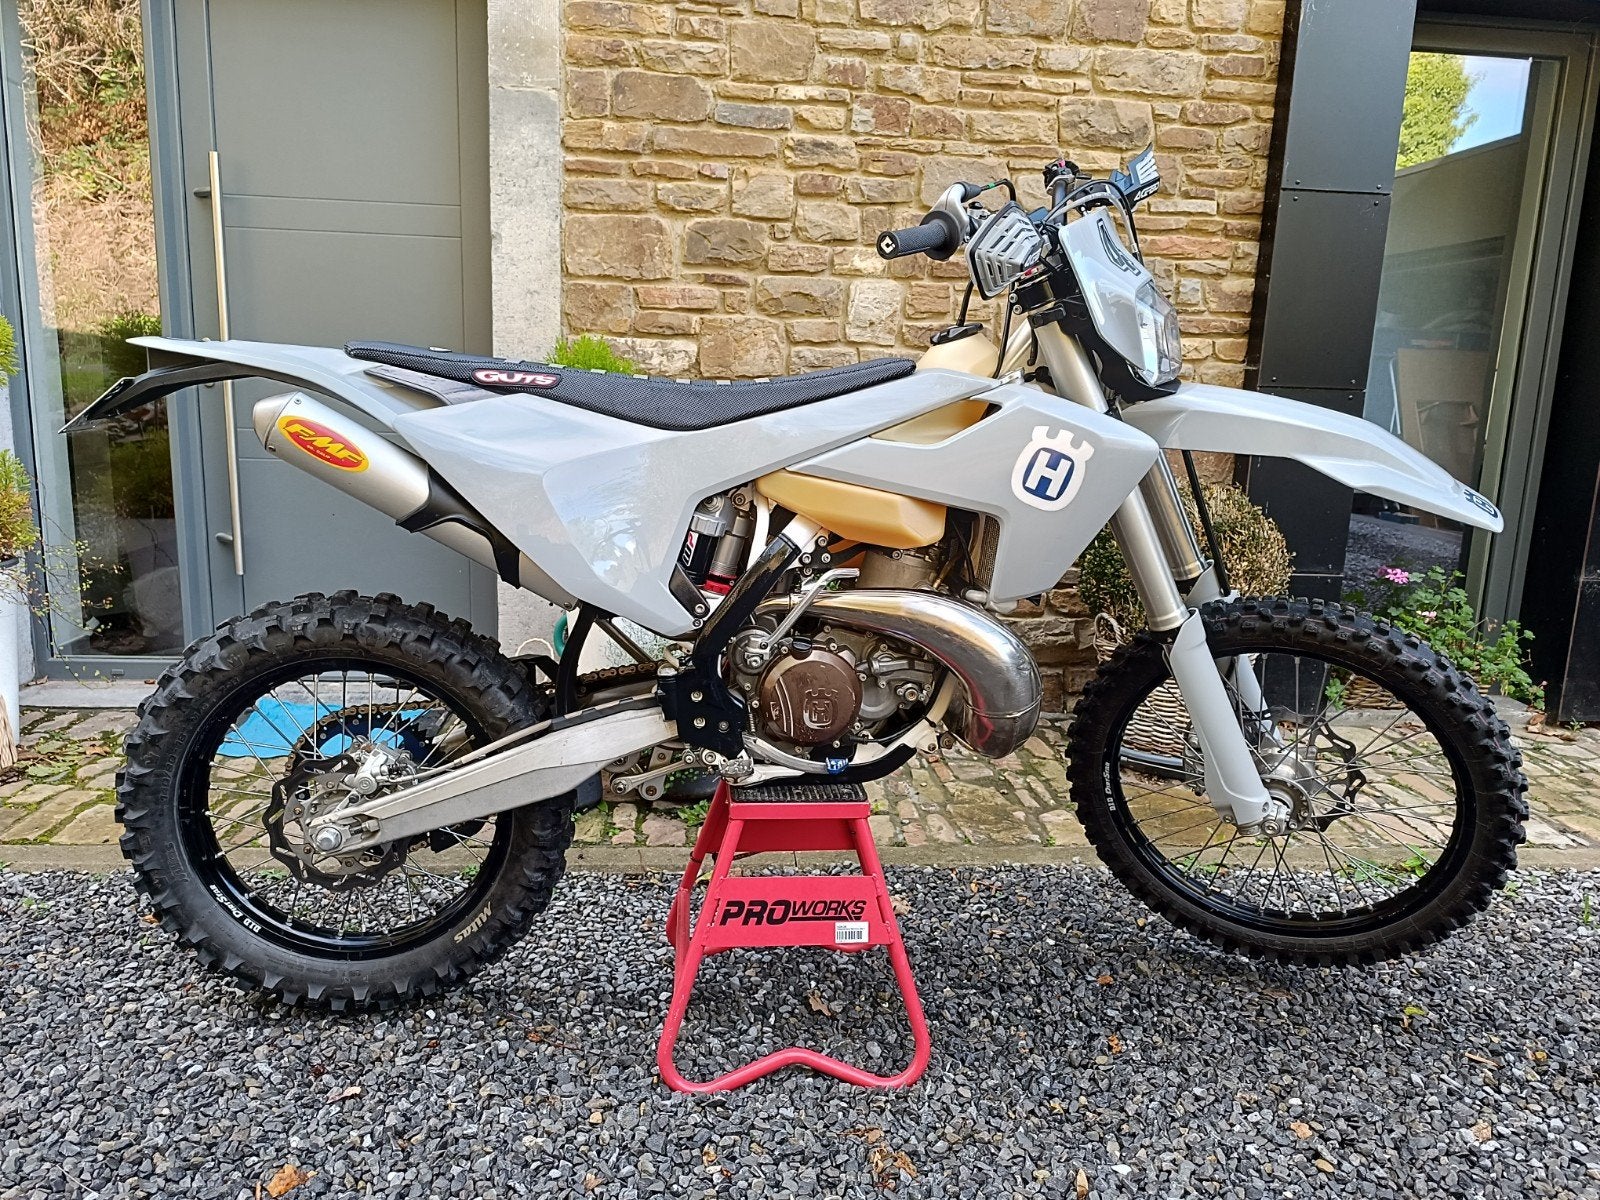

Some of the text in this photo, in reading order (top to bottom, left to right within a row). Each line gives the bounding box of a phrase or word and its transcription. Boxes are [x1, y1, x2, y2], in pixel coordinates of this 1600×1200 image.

[474, 370, 557, 386] GUTS
[282, 423, 366, 464] FMF
[1024, 449, 1073, 499] H
[453, 901, 492, 944] Mitas
